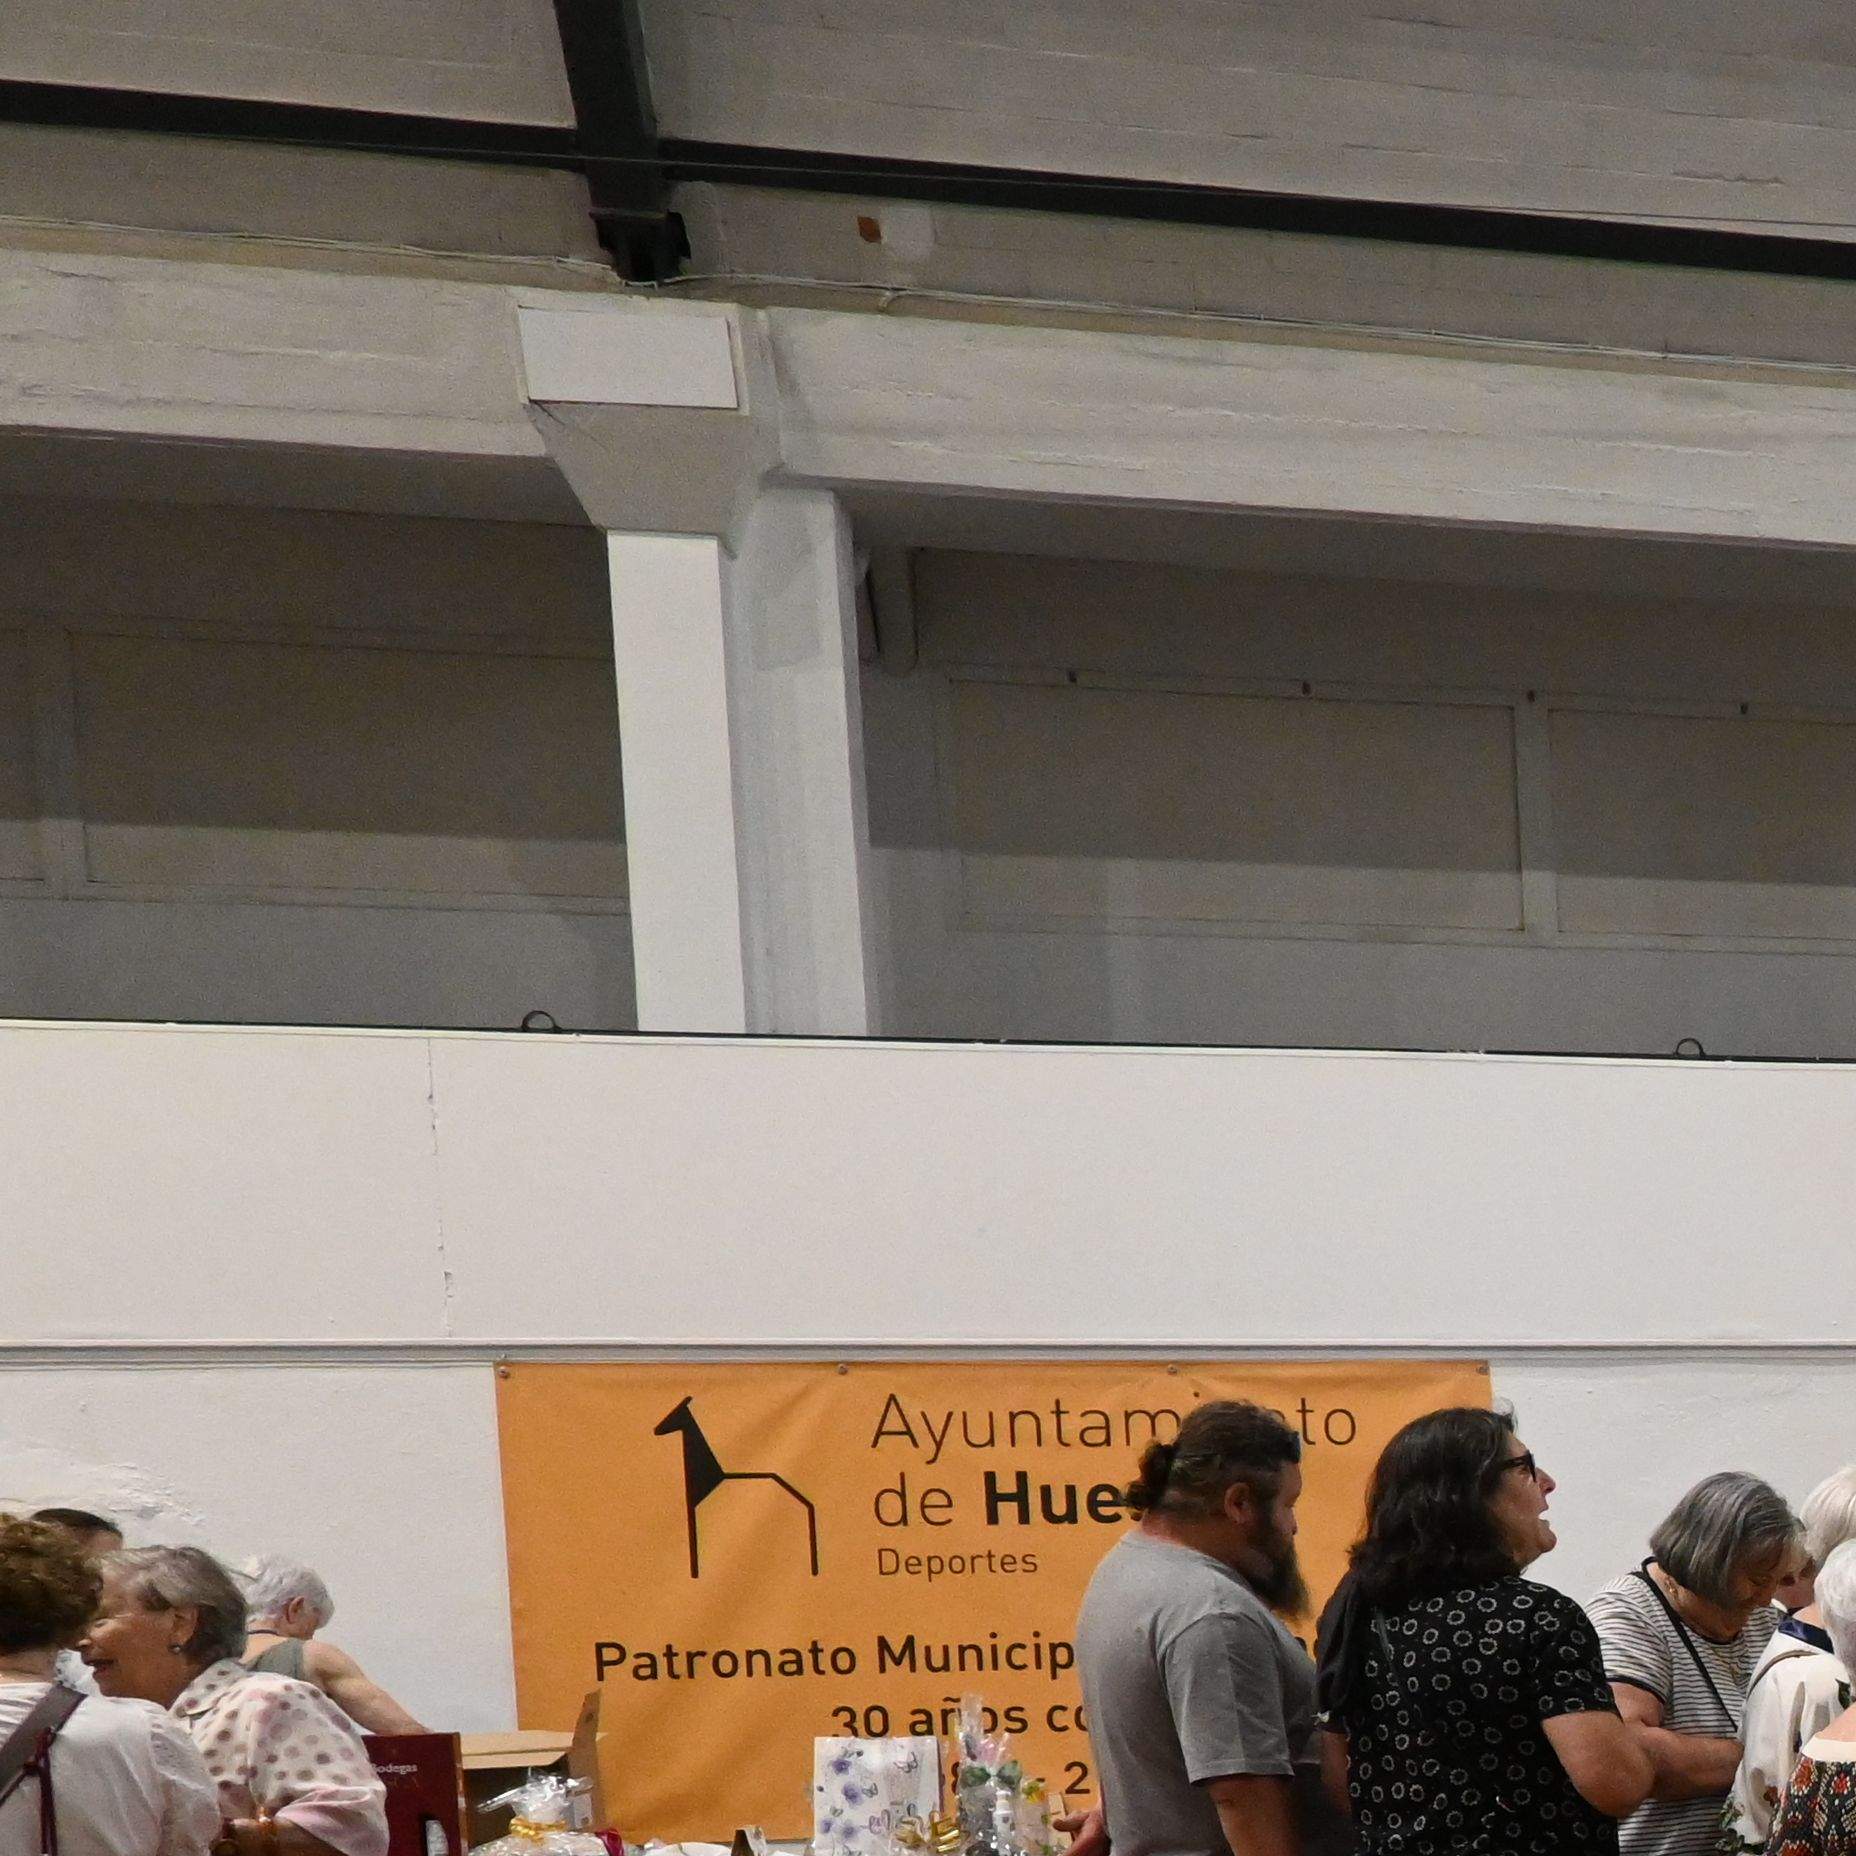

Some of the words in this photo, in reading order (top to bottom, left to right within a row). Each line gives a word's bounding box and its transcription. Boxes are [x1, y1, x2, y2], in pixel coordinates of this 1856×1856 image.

[870, 1392, 1358, 1464] Ayuntamto
[874, 1472, 955, 1528] de
[983, 1470, 1143, 1527] Hue
[877, 1547, 1039, 1583] Deportes
[595, 1640, 857, 1682] Patronato
[878, 1631, 1077, 1680] Municip
[831, 1704, 890, 1738] 30
